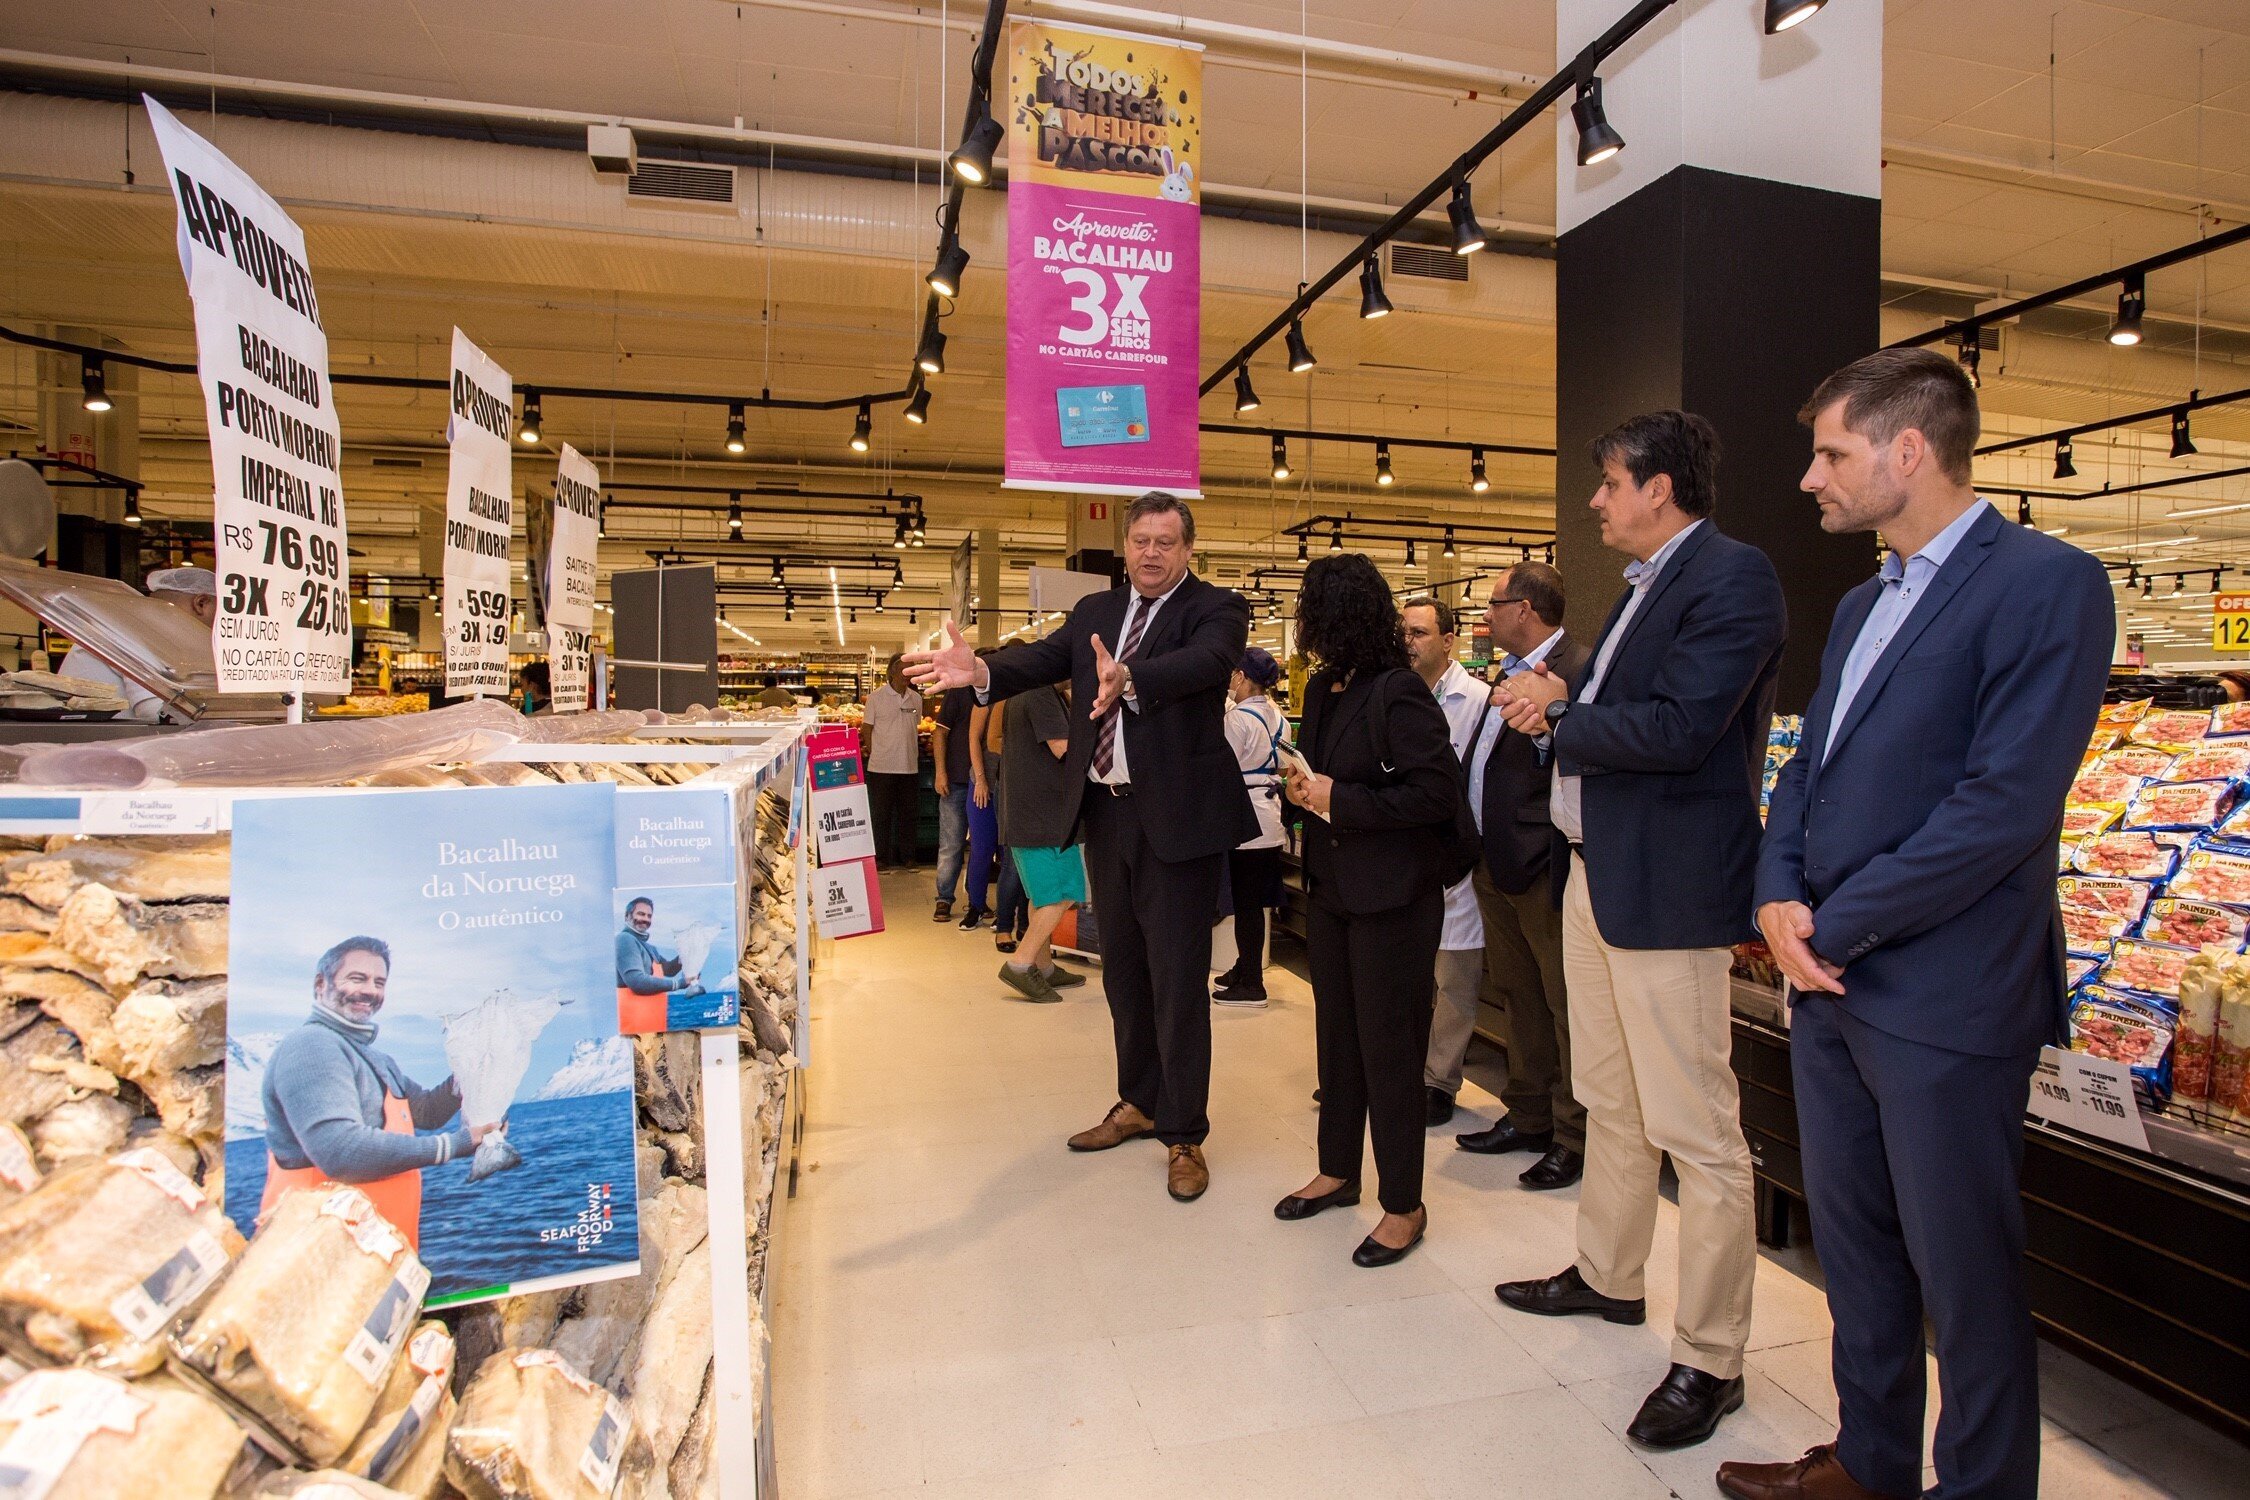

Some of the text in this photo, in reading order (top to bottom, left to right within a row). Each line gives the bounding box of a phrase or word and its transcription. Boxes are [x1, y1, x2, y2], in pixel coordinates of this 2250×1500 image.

[1051, 48, 1144, 97] TODOS
[1040, 77, 1167, 125] MERECEM
[1042, 107, 1171, 145] A MELHOR
[1053, 212, 1157, 242] Aproveite:
[1034, 236, 1172, 273] BACALHAU
[1043, 264, 1060, 274] em
[1110, 318, 1150, 338] SEM
[1109, 336, 1150, 350] JUROS
[1039, 344, 1168, 365] NO CARTÃO CARREFOUR
[238, 324, 320, 409] BACALHAU
[218, 381, 337, 472] PORTO MORHU
[241, 455, 338, 529] IMPERIAL KG
[469, 486, 510, 525] BACALHAU
[448, 519, 476, 552] PORTO
[224, 519, 339, 580] R$ 76,99
[566, 556, 587, 574] SAITHE
[223, 573, 348, 637] 3X R$ 25,66
[220, 617, 280, 641] SEM JUROS
[461, 621, 480, 643] 3X
[2219, 617, 2249, 644] 12
[222, 649, 241, 666] NO
[245, 648, 290, 667] CARTÃO
[562, 655, 573, 671] 3X
[222, 668, 268, 681] CREDITADO
[270, 670, 279, 681] NA
[320, 671, 328, 682] 70
[830, 749, 857, 757] CARREFOUR
[129, 800, 173, 809] Bacalhau
[122, 811, 177, 821] da Noruega
[639, 817, 704, 831] Bacalhau
[824, 811, 837, 832] 3X
[438, 838, 559, 866] Bacalhau
[629, 834, 712, 850] da Noruega
[642, 853, 700, 865] O autêntico
[422, 871, 577, 898] da Noruega
[829, 887, 845, 901] 3X
[438, 906, 563, 931] O autêntico
[2179, 903, 2222, 917] PAINEIRA
[703, 1010, 734, 1019] SEAFOOD
[2100, 1010, 2147, 1030] PAINEIRA
[2079, 1068, 2091, 1077] COM
[2097, 1073, 2118, 1083] CUPOM
[2039, 1081, 2071, 1103] 14,99
[2090, 1096, 2125, 1118] 11,99
[588, 1183, 603, 1245] NORWAY
[541, 1220, 613, 1243] SEAFOOD
[577, 1210, 590, 1253] FROM
